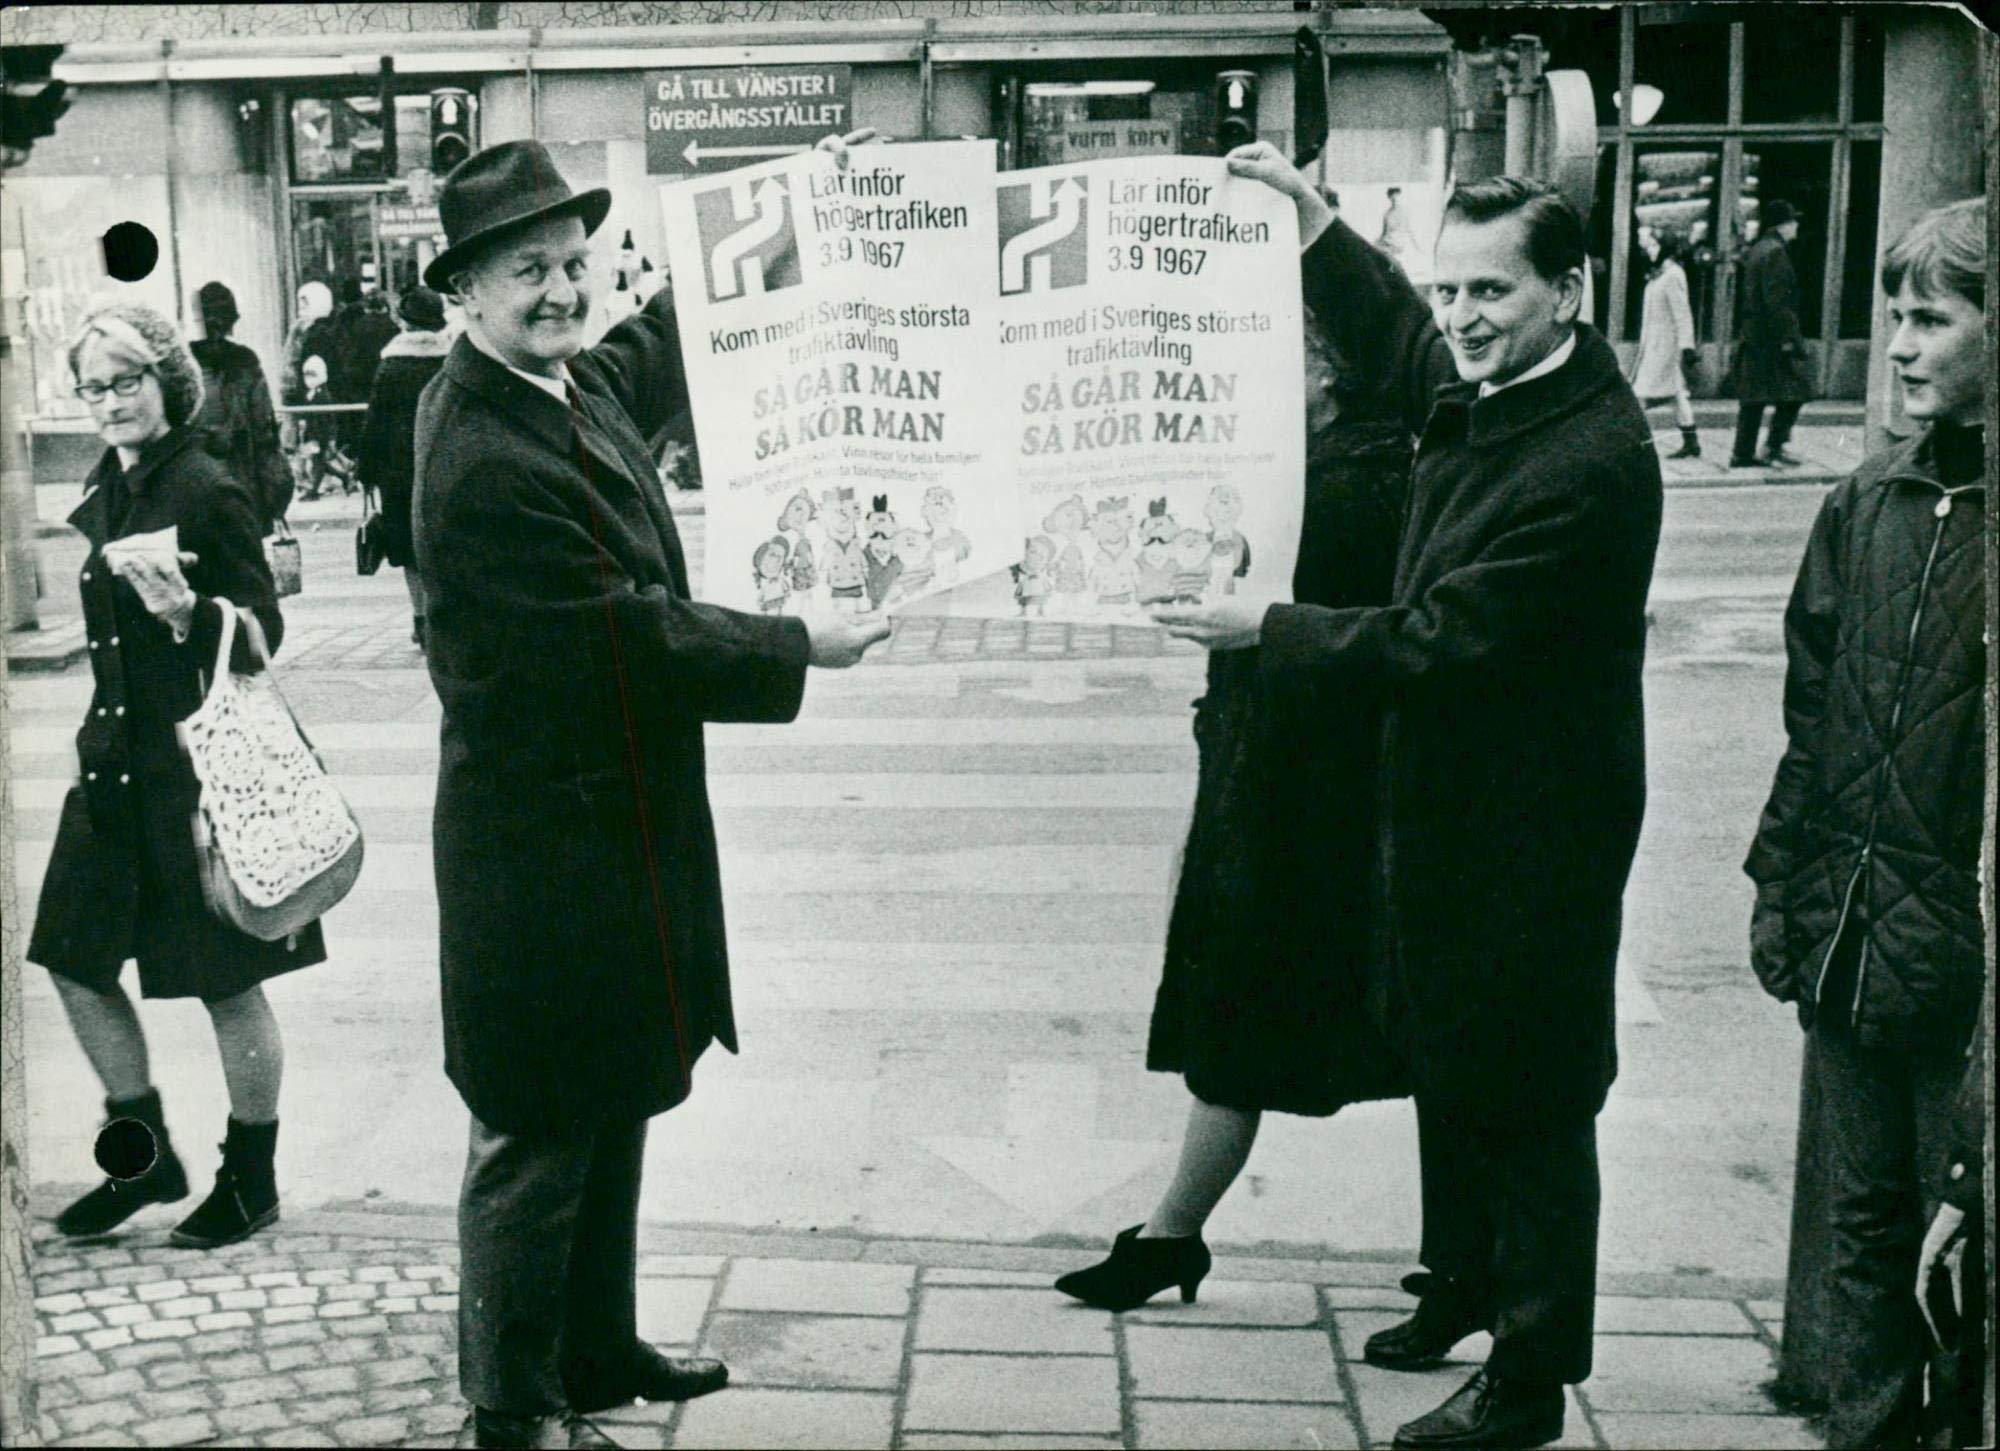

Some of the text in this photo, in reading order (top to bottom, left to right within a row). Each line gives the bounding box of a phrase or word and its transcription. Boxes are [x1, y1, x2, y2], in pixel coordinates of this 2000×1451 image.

[658, 73, 835, 100] GÅ TILL VÄNSTER I
[649, 101, 845, 131] ÖVERGÅNGSSTÄLLET
[1127, 127, 1169, 147] korv
[809, 167, 906, 199] Lär inför
[1108, 177, 1213, 206] Lär inför
[814, 200, 969, 233] högertrafiken
[1108, 211, 1270, 244] högertrafiken
[861, 238, 905, 269] 1967
[1108, 246, 1207, 276] 3.9 1967
[709, 327, 761, 355] Kom
[765, 313, 805, 344] med
[818, 297, 896, 327] Sveriges
[899, 302, 970, 328] största
[1043, 310, 1086, 338] med
[1102, 304, 1192, 334] Sveriges
[1197, 309, 1271, 334] största
[789, 328, 899, 365] trafiktävling
[1067, 334, 1192, 366] trafiktävling
[752, 361, 942, 419] SÅ GÅR MAN
[1021, 364, 1238, 414] SÅ GÅR MAN
[755, 400, 946, 461] SÅ KÖR MAN
[1020, 407, 1240, 456] SÅ KÖR MAN
